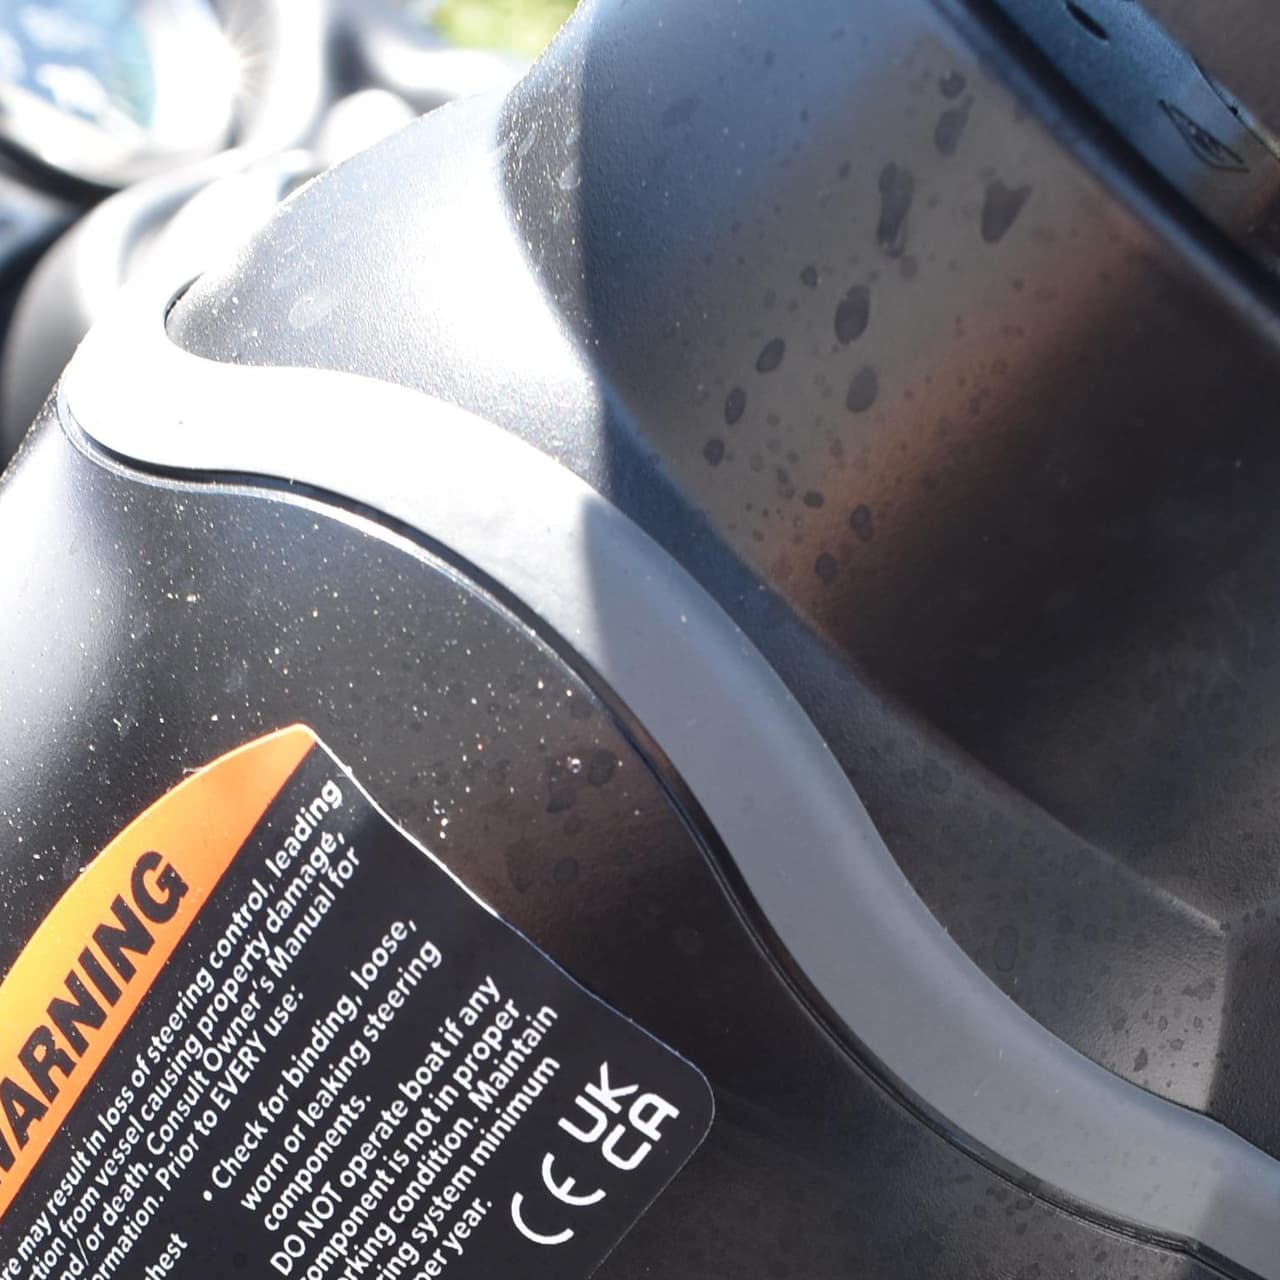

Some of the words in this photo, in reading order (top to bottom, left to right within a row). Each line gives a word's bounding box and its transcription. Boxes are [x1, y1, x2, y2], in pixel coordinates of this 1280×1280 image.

[16, 1210, 53, 1262] may
[45, 1149, 93, 1217] result
[81, 1129, 107, 1157] in
[96, 1084, 136, 1134] loss
[130, 1052, 152, 1089] of
[146, 966, 216, 1065] steering
[208, 877, 276, 970] control,
[264, 778, 345, 879] leading
[58, 1185, 102, 1240] from
[93, 1113, 146, 1188] vessel
[139, 1032, 205, 1123] causing
[195, 929, 272, 1042] property
[265, 830, 346, 935] damage,
[101, 1161, 154, 1228] death.
[145, 1069, 211, 1156] Consult
[264, 881, 337, 979] Manual
[329, 845, 361, 889] for
[153, 1131, 200, 1192] Prior
[192, 1108, 219, 1137] to
[208, 1028, 268, 1112] EVERY
[262, 983, 305, 1038] use:
[210, 1119, 270, 1190] Check
[257, 1083, 290, 1124] for
[280, 993, 364, 1089] binding,
[349, 919, 418, 991] loose,
[239, 1151, 290, 1212] worn
[282, 1122, 307, 1154] or
[296, 1038, 372, 1129] leaking
[362, 939, 443, 1044] steering
[381, 1148, 411, 1175] is
[402, 1106, 442, 1153] not
[427, 1083, 460, 1113] in
[451, 997, 521, 1092] proper
[387, 1116, 480, 1225] condition.
[466, 1005, 559, 1113] Maintain
[556, 1060, 640, 1144] UK
[263, 1094, 372, 1232] components.
[268, 1233, 307, 1277] DO
[296, 1180, 344, 1240] NOT
[338, 1099, 410, 1189] operate
[397, 1040, 452, 1103] boat
[442, 1016, 465, 1047] if
[457, 974, 502, 1027] any
[410, 1163, 478, 1245] system
[469, 1056, 561, 1167] minimum
[440, 1196, 493, 1257] year.
[509, 1151, 607, 1246] CE
[600, 1091, 681, 1172] CA
